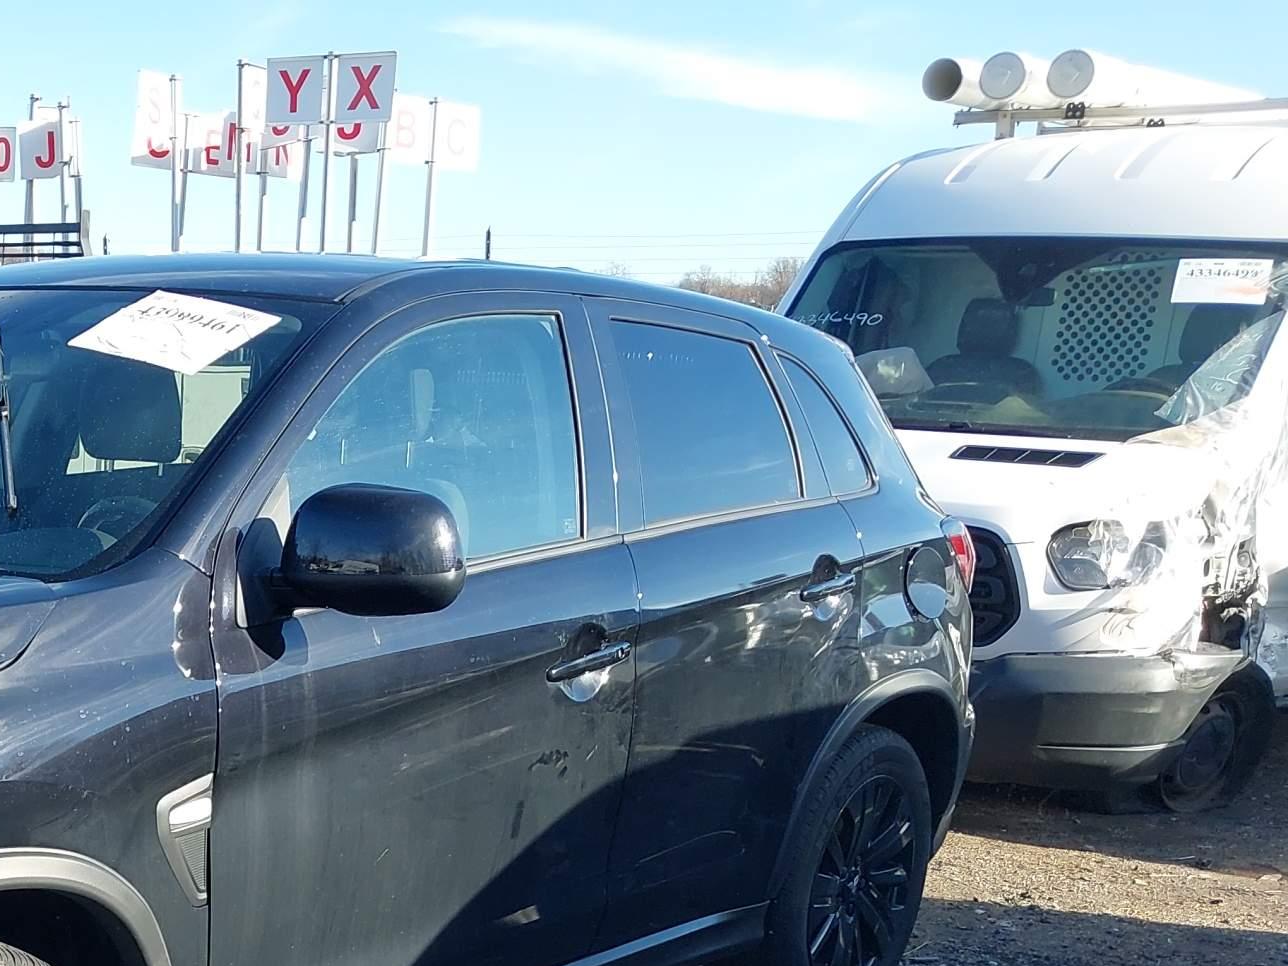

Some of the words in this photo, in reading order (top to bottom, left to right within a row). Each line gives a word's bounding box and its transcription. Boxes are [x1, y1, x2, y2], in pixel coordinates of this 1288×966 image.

[279, 69, 311, 113] Y
[347, 64, 383, 111] X
[35, 131, 56, 168] J
